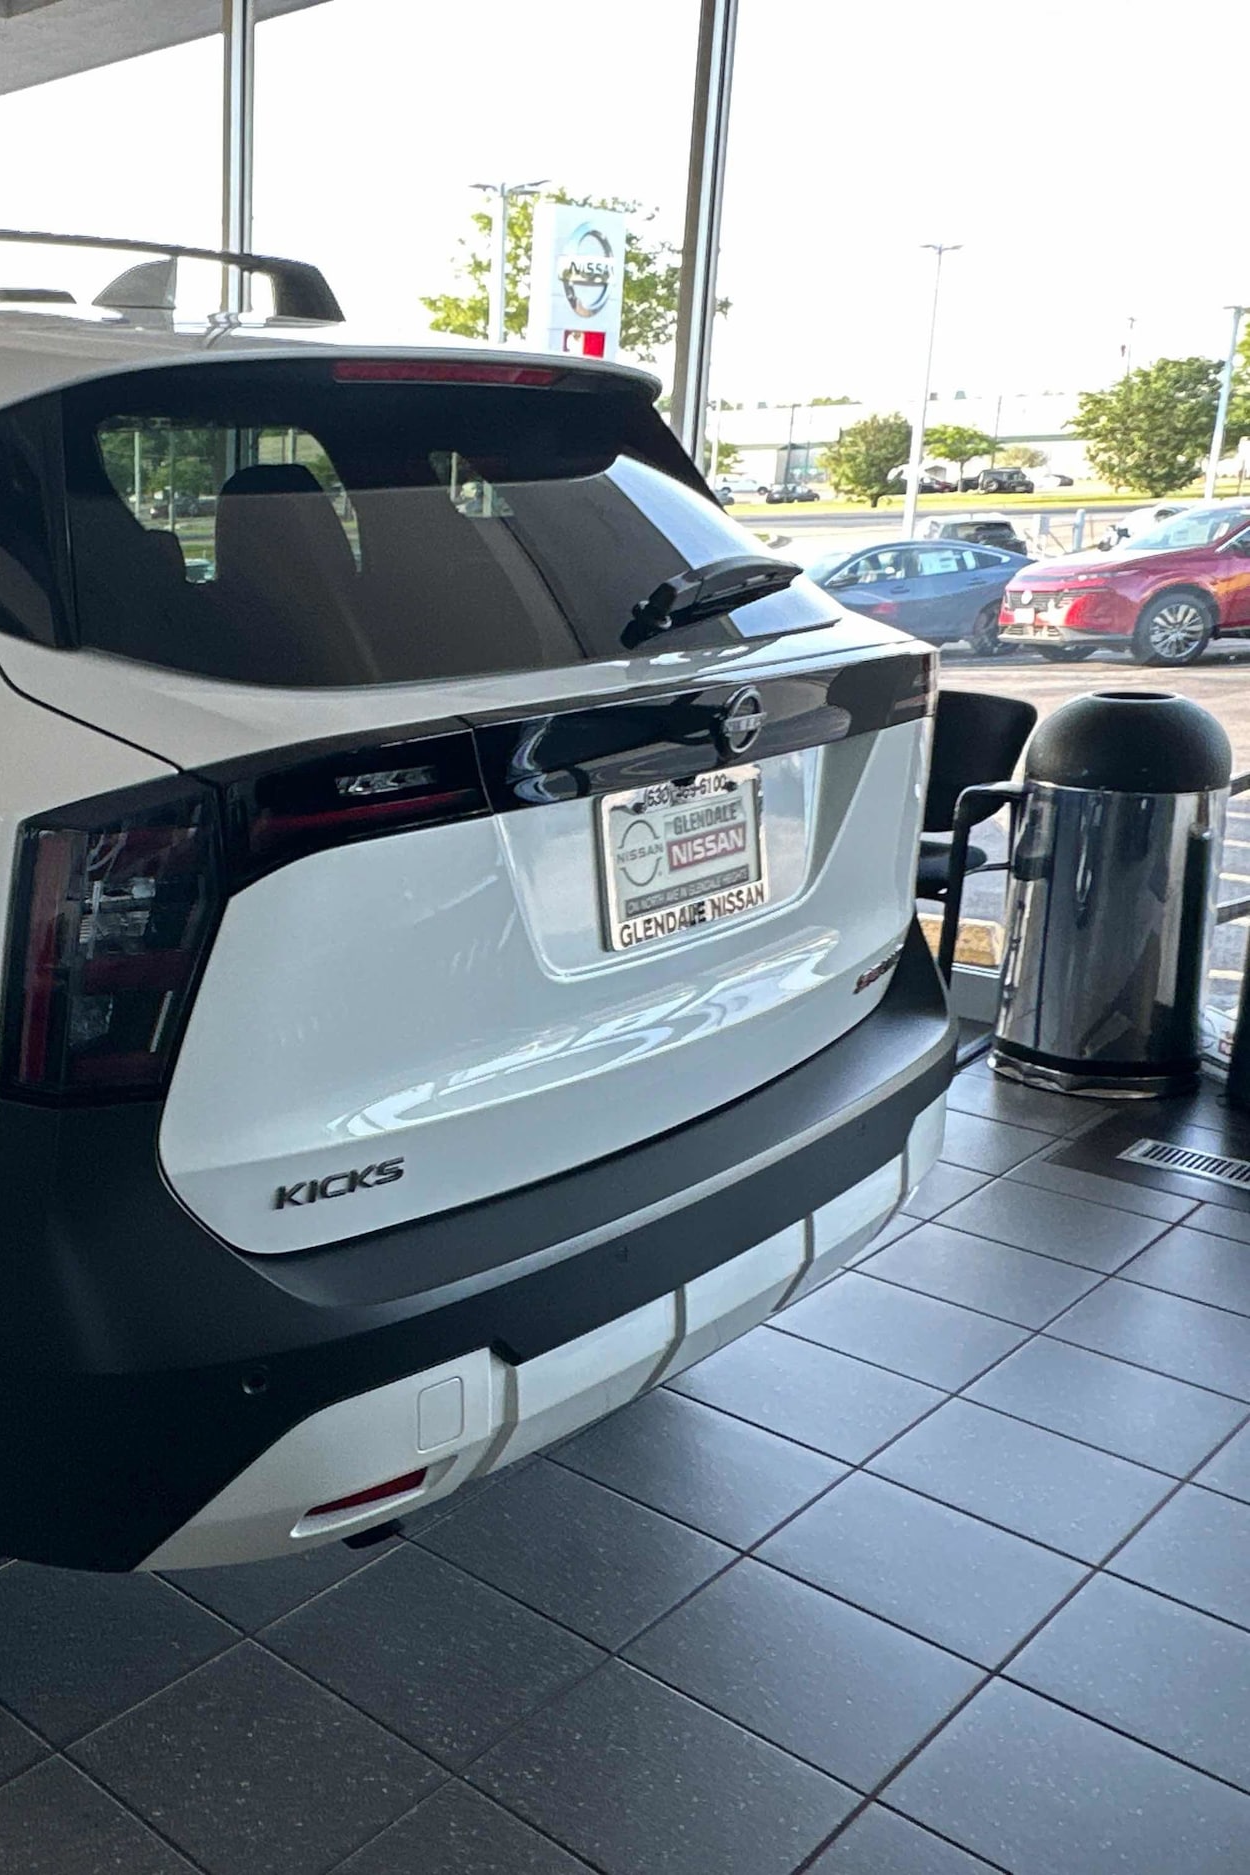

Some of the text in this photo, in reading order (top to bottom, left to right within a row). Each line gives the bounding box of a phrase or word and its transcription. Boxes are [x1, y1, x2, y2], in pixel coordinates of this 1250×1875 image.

[673, 802, 737, 835] GLENDALE
[616, 843, 664, 863] NISSAN
[671, 827, 744, 867] NISSAN
[620, 883, 765, 948] GLENDALE NISSAN
[271, 1156, 405, 1210] KICKS
